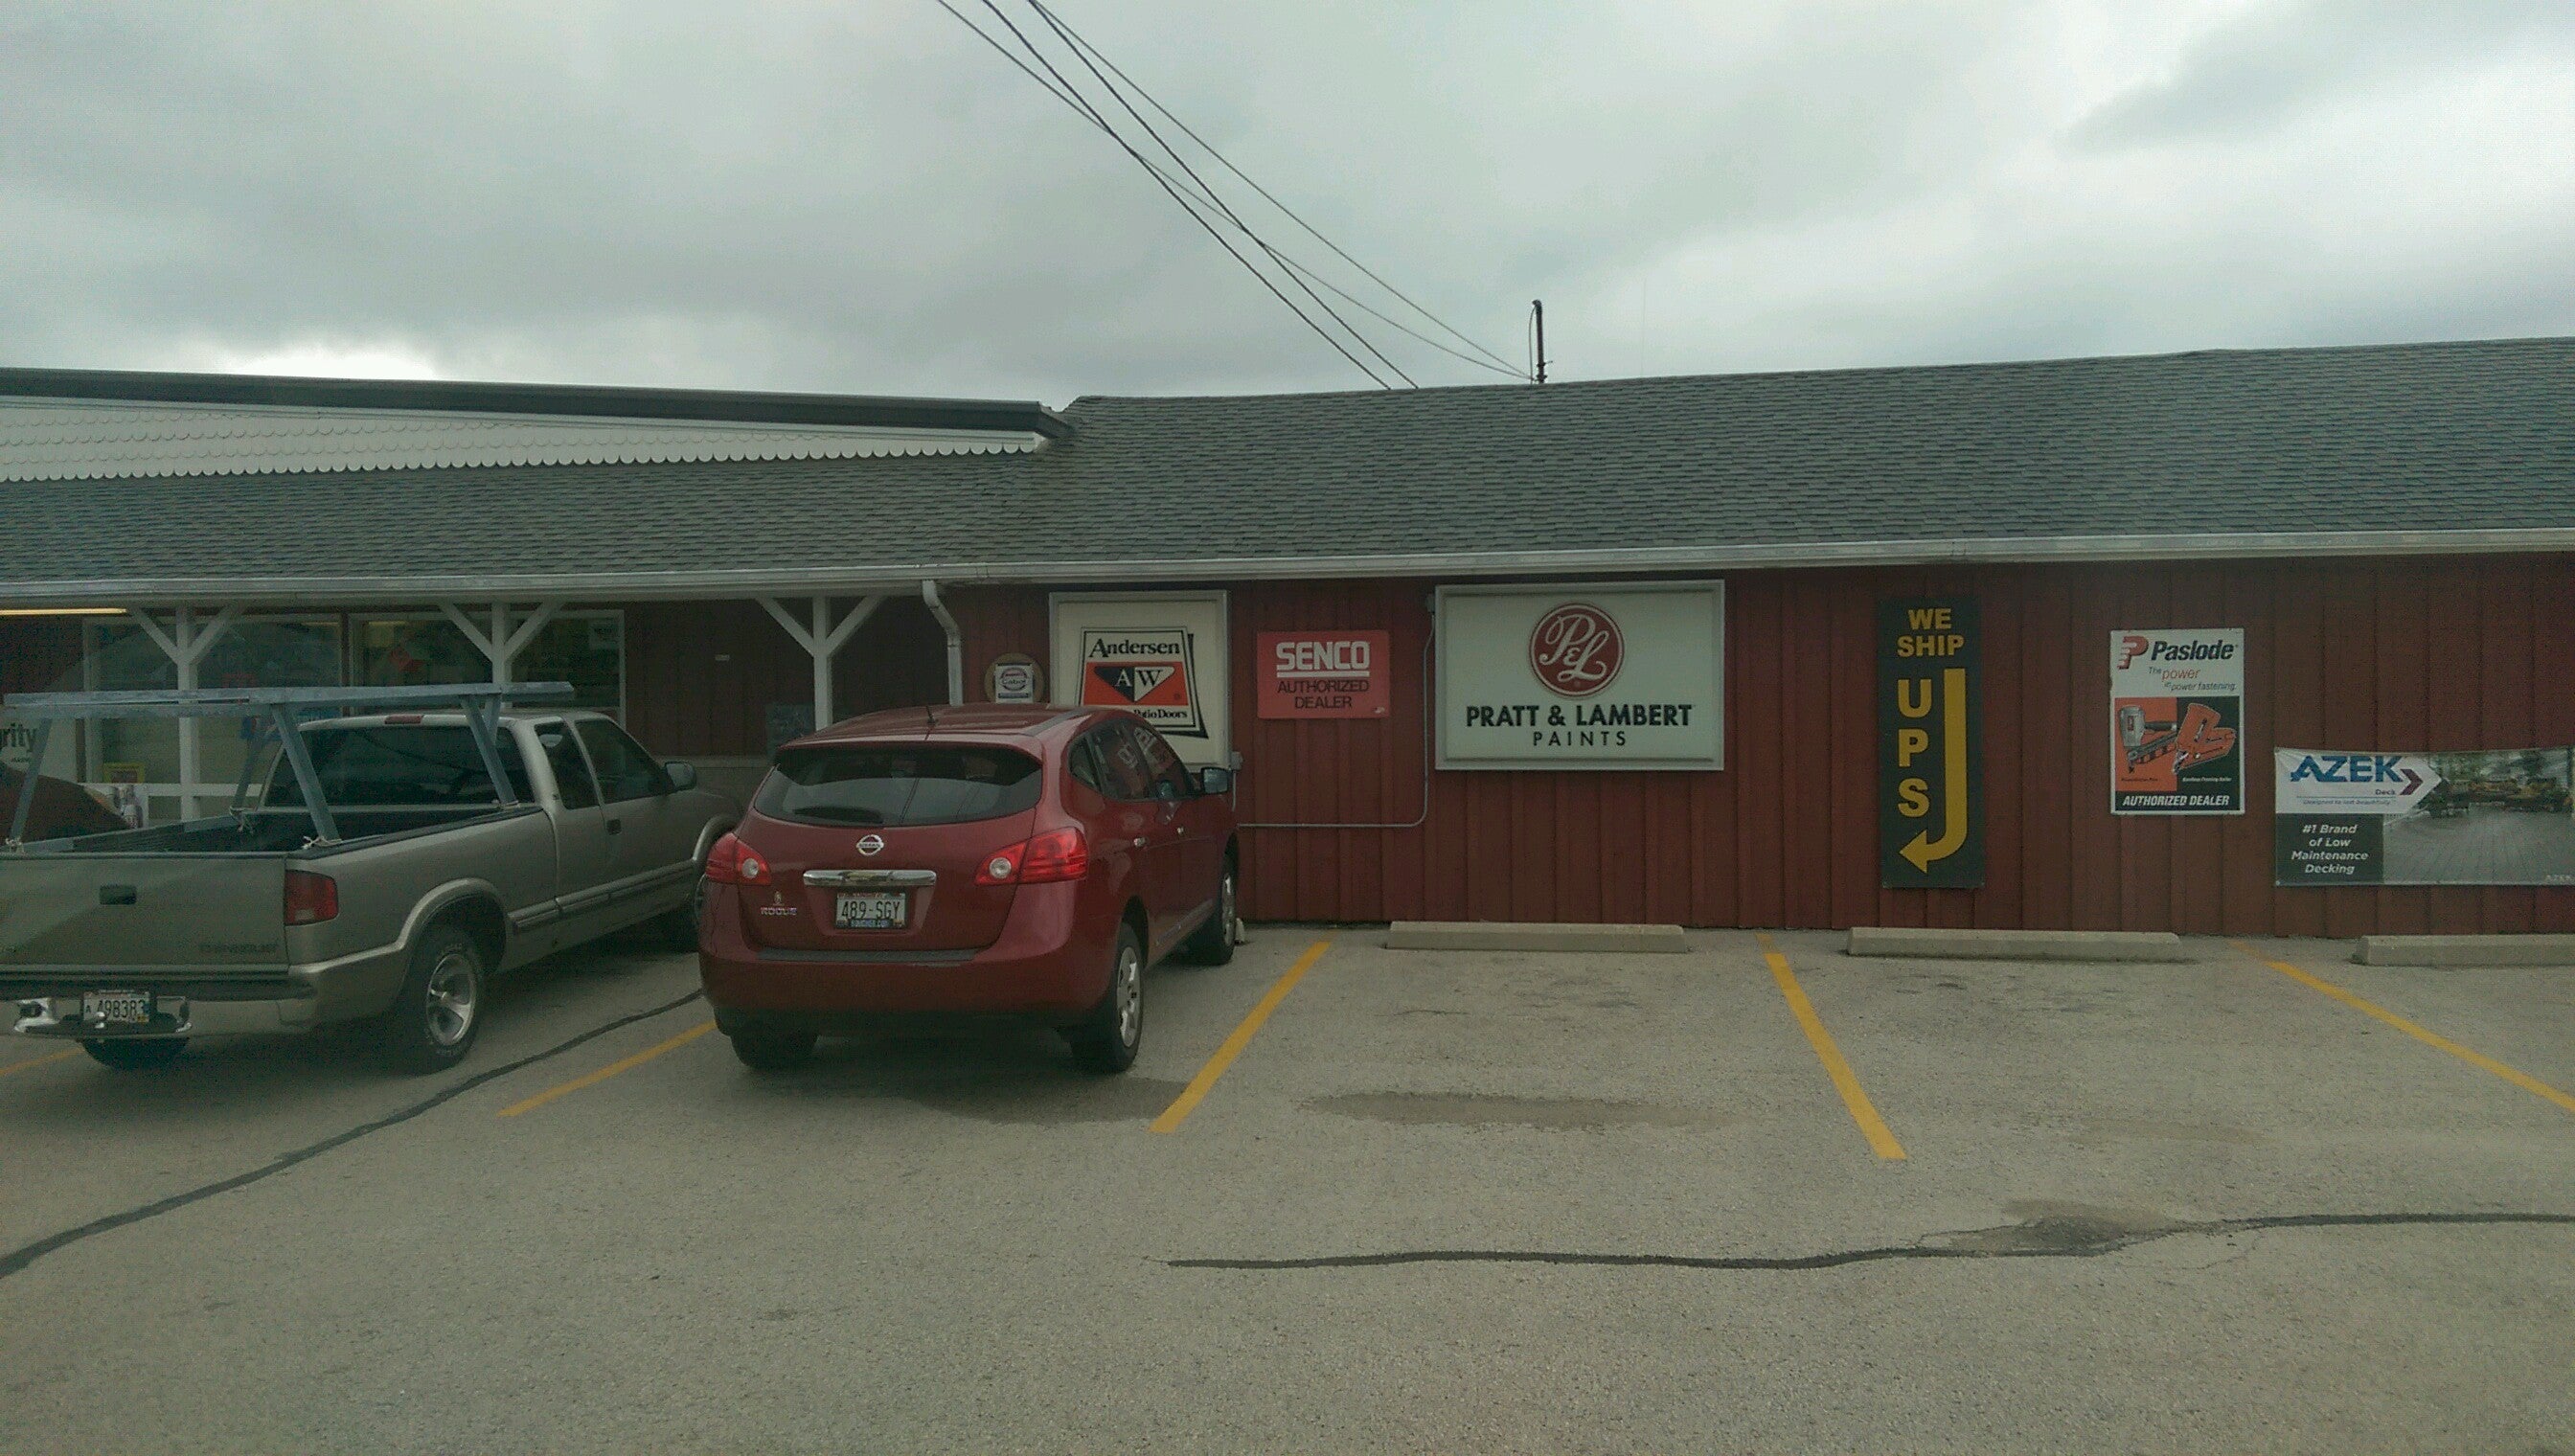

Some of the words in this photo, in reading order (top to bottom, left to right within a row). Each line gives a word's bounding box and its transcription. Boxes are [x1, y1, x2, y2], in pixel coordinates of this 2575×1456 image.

[1908, 608, 1951, 630] WE
[1088, 638, 1180, 658] Andersen
[1898, 635, 1964, 657] SHIP
[2151, 640, 2234, 661] Paslode
[1276, 641, 1370, 671] SENCO
[2162, 669, 2200, 681] power
[1277, 679, 1370, 694] AUTHORIZED
[1295, 695, 1352, 709] DEALER
[1157, 709, 1188, 718] Doors
[1466, 705, 1539, 727] PRATT
[1547, 705, 1566, 726] &
[1577, 704, 1693, 726] LAMBERT
[0, 722, 36, 752] rity
[1533, 731, 1627, 746] PAINTS
[2290, 755, 2404, 783] AZEK
[2122, 795, 2188, 807] AUTHORIZED
[2189, 795, 2230, 806] DEALER
[2302, 825, 2316, 833] #1
[2319, 825, 2358, 833] Brand
[2309, 838, 2323, 847] of
[2325, 838, 2351, 847] Low
[2290, 851, 2369, 860] Maintenance
[2305, 864, 2355, 875] Decking
[841, 901, 900, 919] 489-SGY
